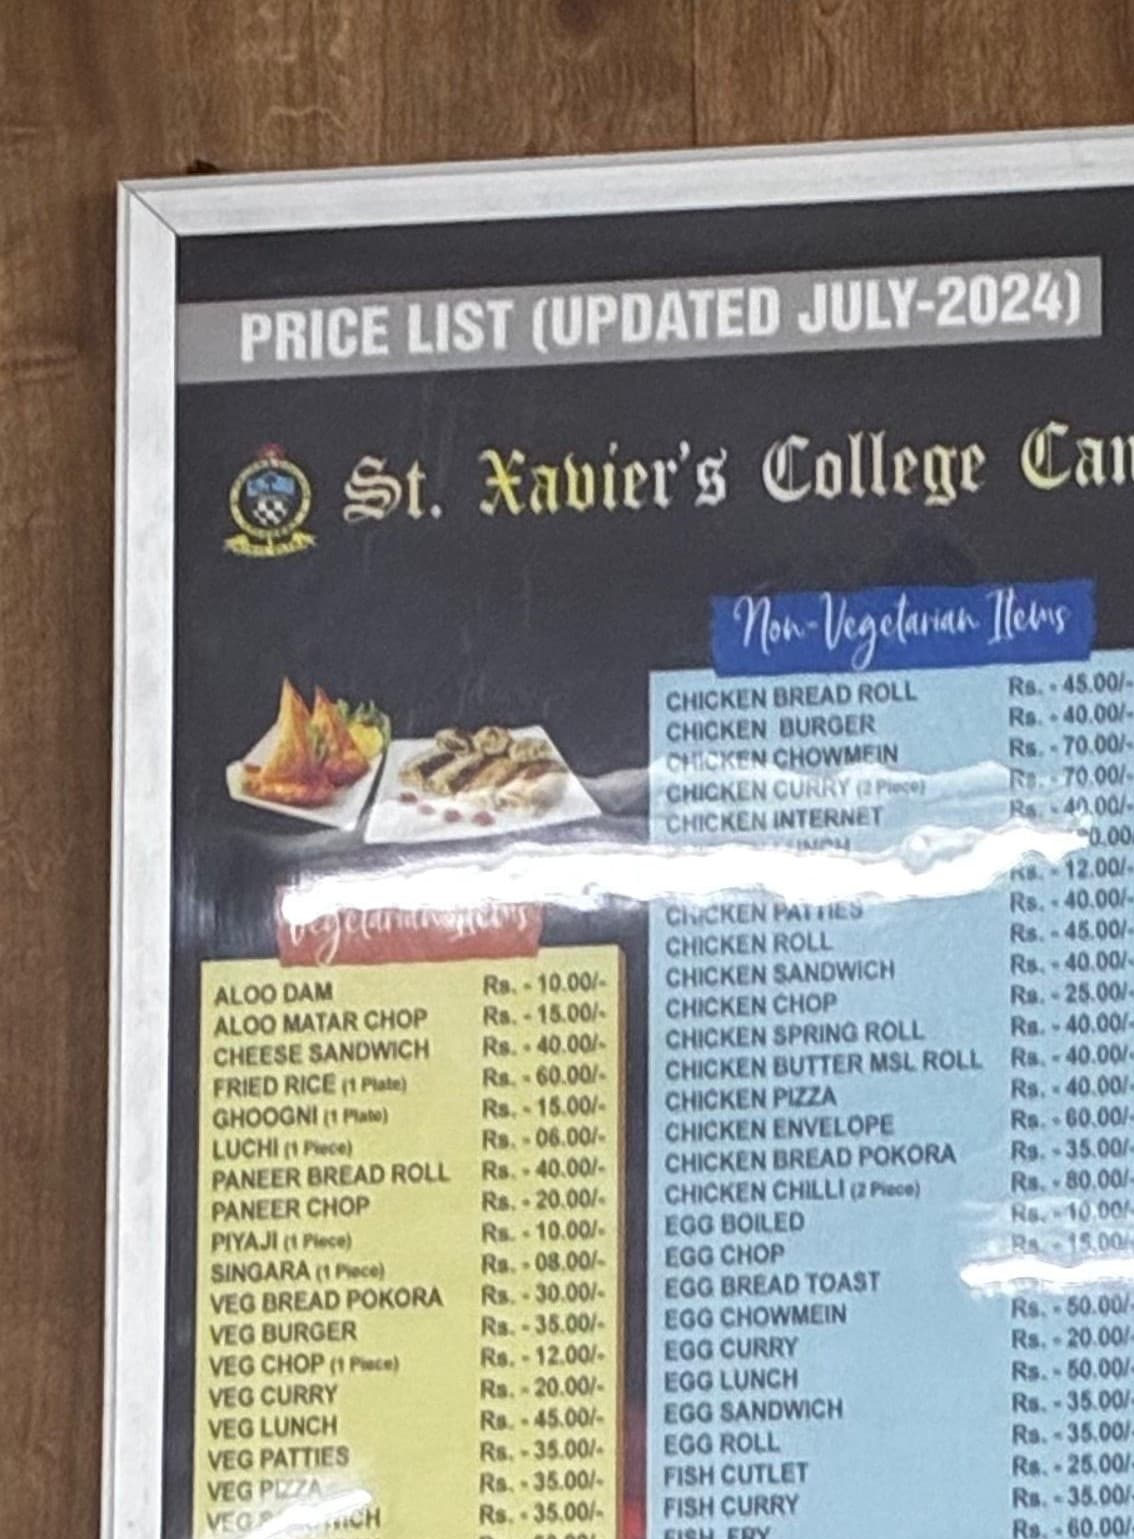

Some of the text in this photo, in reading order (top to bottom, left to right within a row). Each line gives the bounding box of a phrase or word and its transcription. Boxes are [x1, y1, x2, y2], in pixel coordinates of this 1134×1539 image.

[239, 269, 1082, 363] PRICE LIST (UPDATED JULY-2024)
[343, 455, 442, 522] St.
[477, 440, 728, 515] Xavier's
[762, 430, 986, 507] College
[733, 587, 1069, 673] Non-Vegetarian Items
[666, 671, 1134, 712] CHICKEN BREAD ROLL Rs. 45.00/-
[666, 714, 876, 742] CHICKEN BURGER
[666, 959, 895, 988] CHICKEN SANDWICH
[214, 971, 607, 1006] ALOO DAM Rs. 10.00/-
[214, 1002, 606, 1036] ALOO MATAR CHOP Rs. 15.00/-
[666, 992, 837, 1019] CHICKEN CHOP
[666, 1020, 924, 1049] CHICKEN SPRING ROLL
[213, 1038, 429, 1067] CHEESE SANDWICH
[666, 1049, 982, 1080] CHICKEN BUTTER MSL ROLL
[213, 1074, 336, 1097] FRIED RICE
[666, 1085, 837, 1111] CHICKEN PIZZA
[213, 1106, 318, 1128] GHOOGNI
[212, 1162, 450, 1190] PANEER BREAD ROLL
[212, 1195, 370, 1221] PANEER CHOP
[665, 1211, 804, 1235] EGG BOILED
[665, 1270, 880, 1298] EGG BREAD TOAST
[210, 1285, 443, 1314] VEG BREAD POKORA
[665, 1303, 847, 1329] EGG CHOWMEIN
[210, 1320, 357, 1345] VEG BURGER
[664, 1368, 799, 1392] EGG LUNCH
[209, 1383, 338, 1408] VEG CURRY
[664, 1397, 843, 1423] EGG SANDWICH
[208, 1414, 337, 1440] VEG LUNCH
[208, 1444, 349, 1470] VEG PATTIES
[664, 1462, 808, 1486] FISH CUTLET
